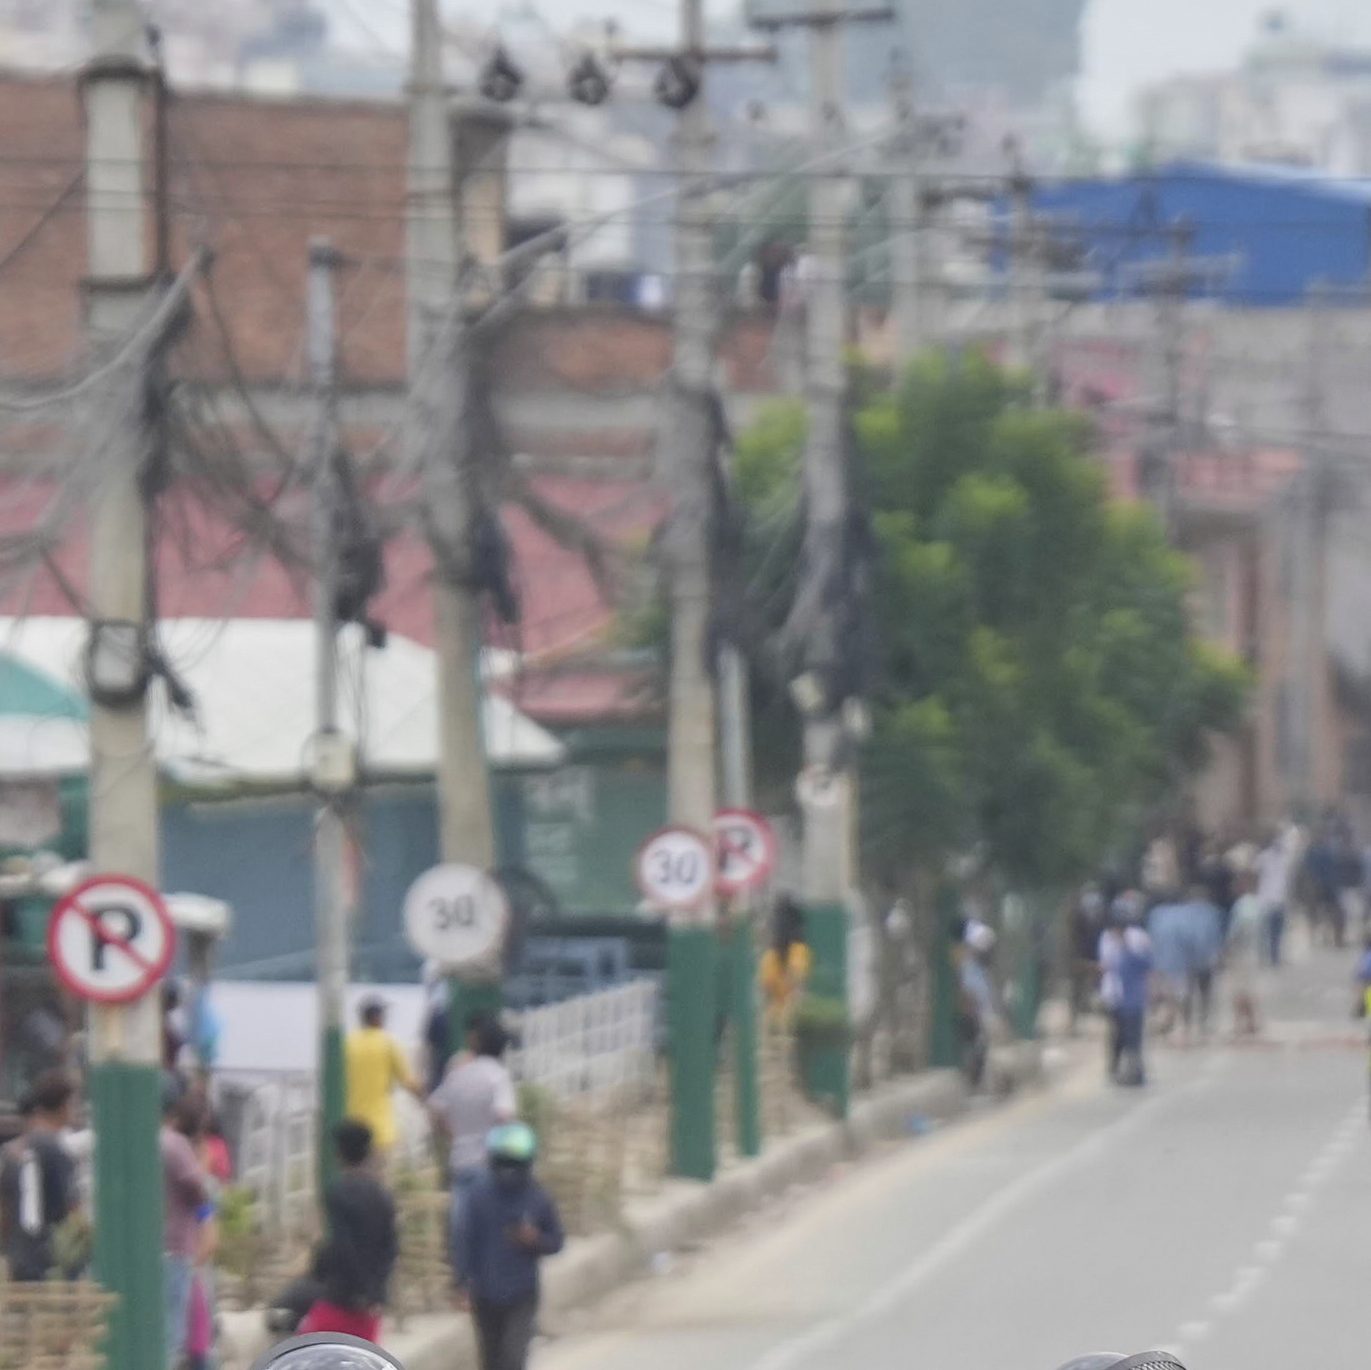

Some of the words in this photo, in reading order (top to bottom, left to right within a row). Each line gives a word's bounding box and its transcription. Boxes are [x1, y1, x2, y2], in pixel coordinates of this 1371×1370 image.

[652, 850, 699, 884] 30
[426, 895, 475, 931] 30
[91, 902, 141, 971] P
